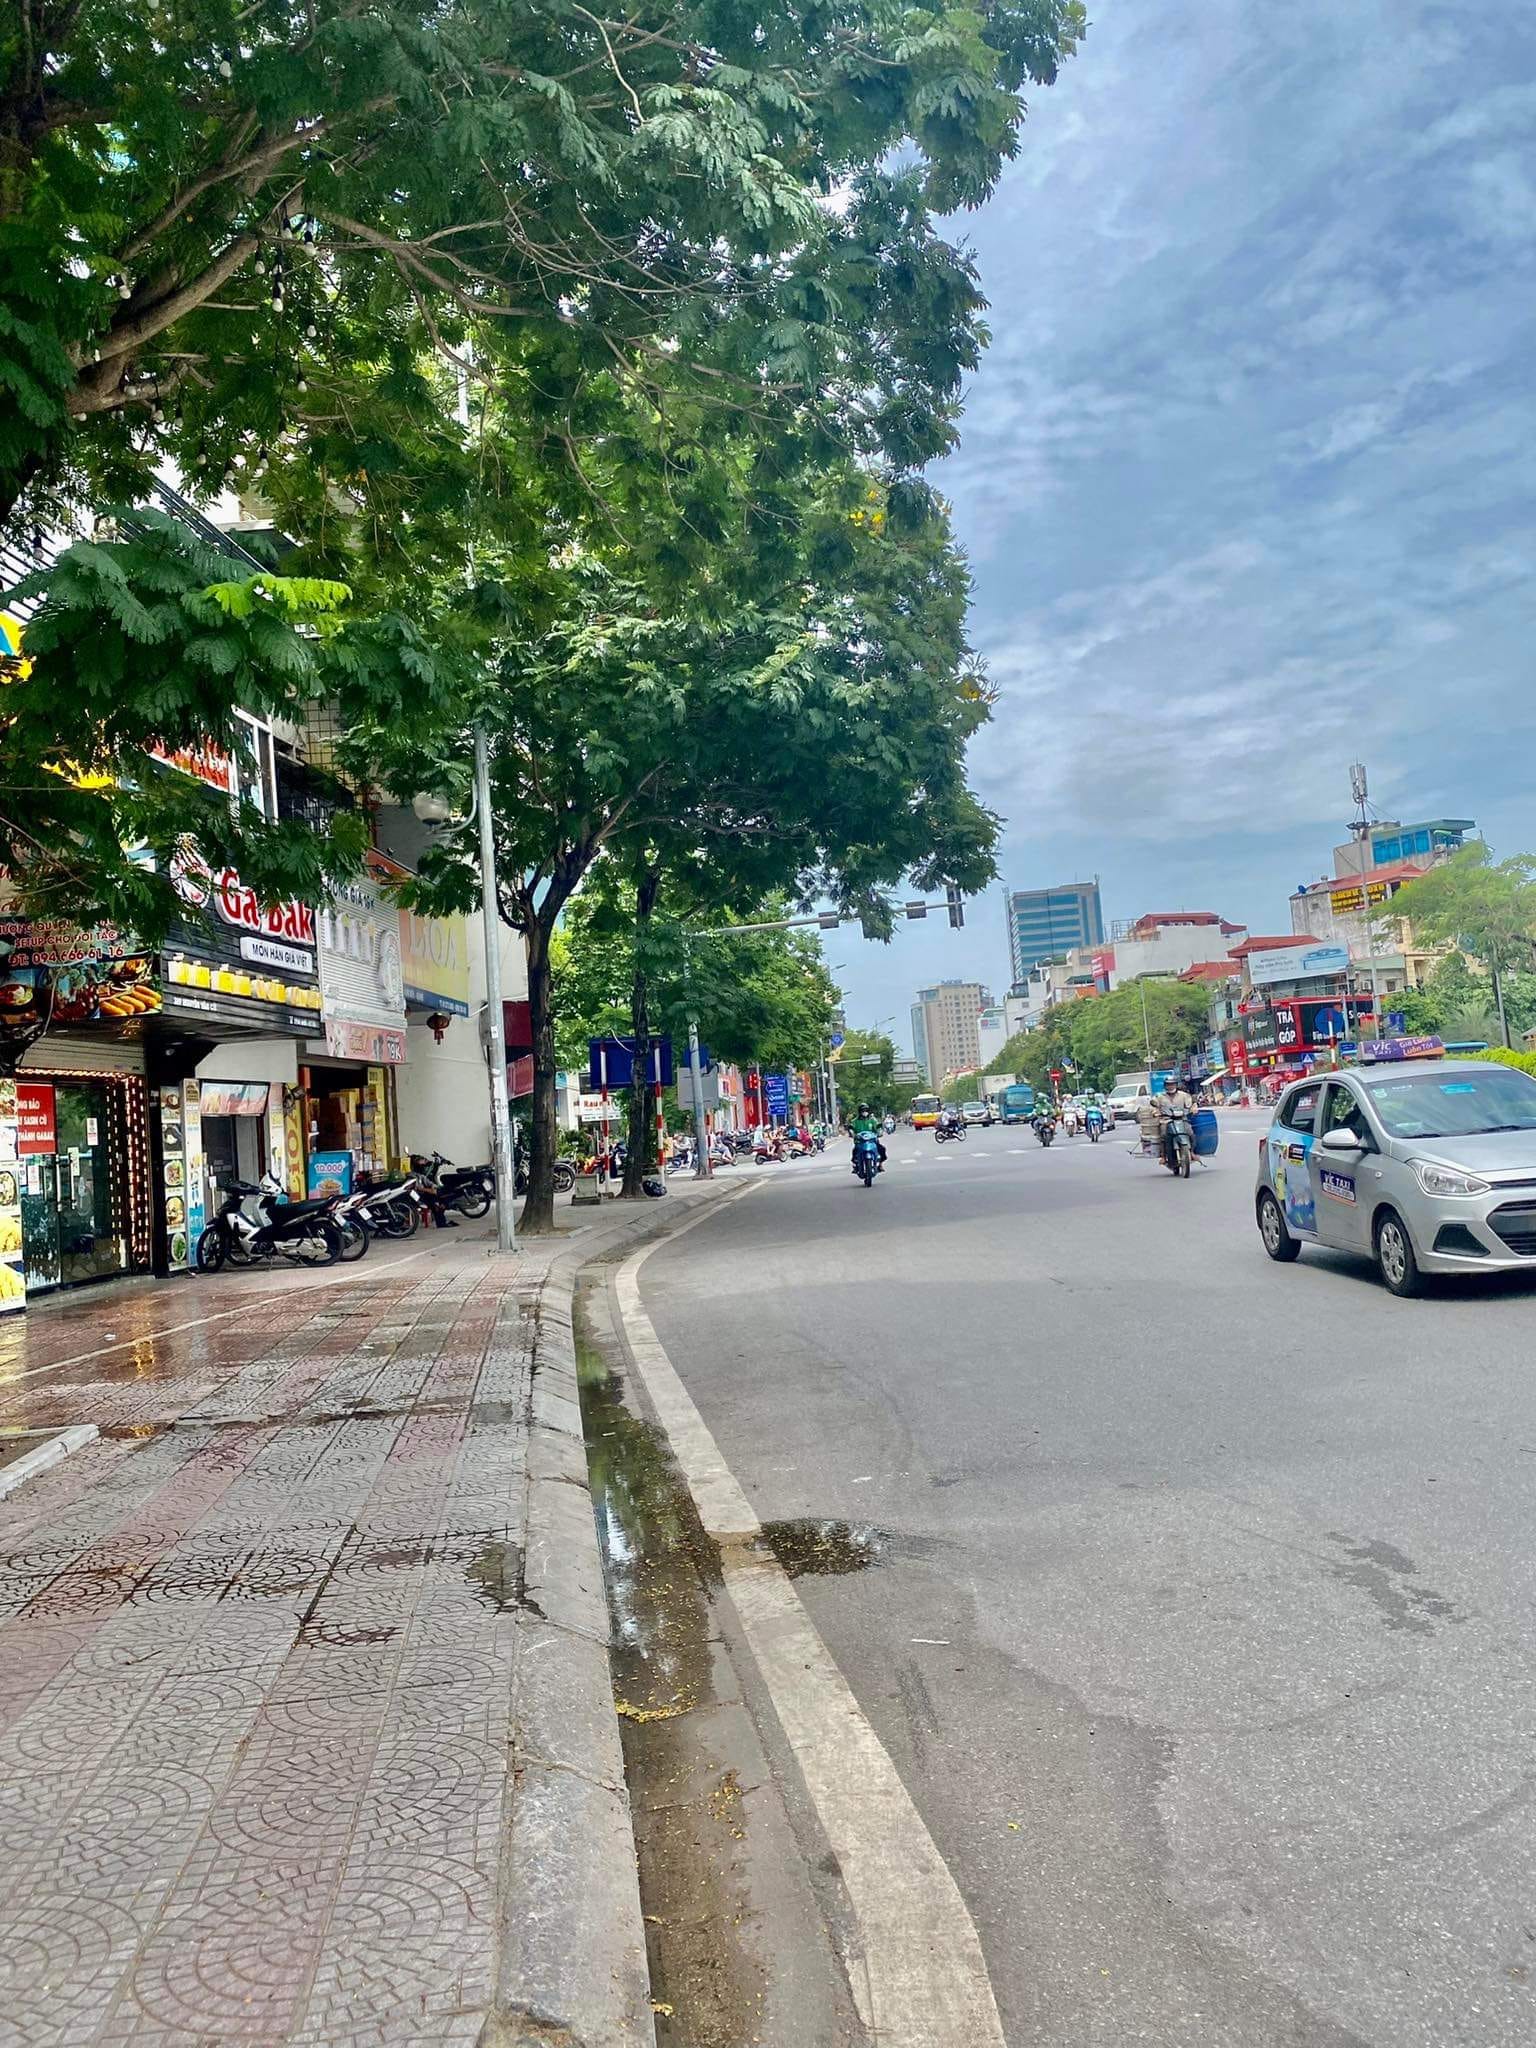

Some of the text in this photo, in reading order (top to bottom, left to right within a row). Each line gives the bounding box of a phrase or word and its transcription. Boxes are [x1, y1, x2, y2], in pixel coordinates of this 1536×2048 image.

[47, 935, 70, 944] CHO
[33, 950, 57, 964] 094
[61, 949, 84, 961] 666
[88, 947, 101, 959] 61
[109, 945, 124, 957] 16
[1279, 1027, 1296, 1044] GÓP
